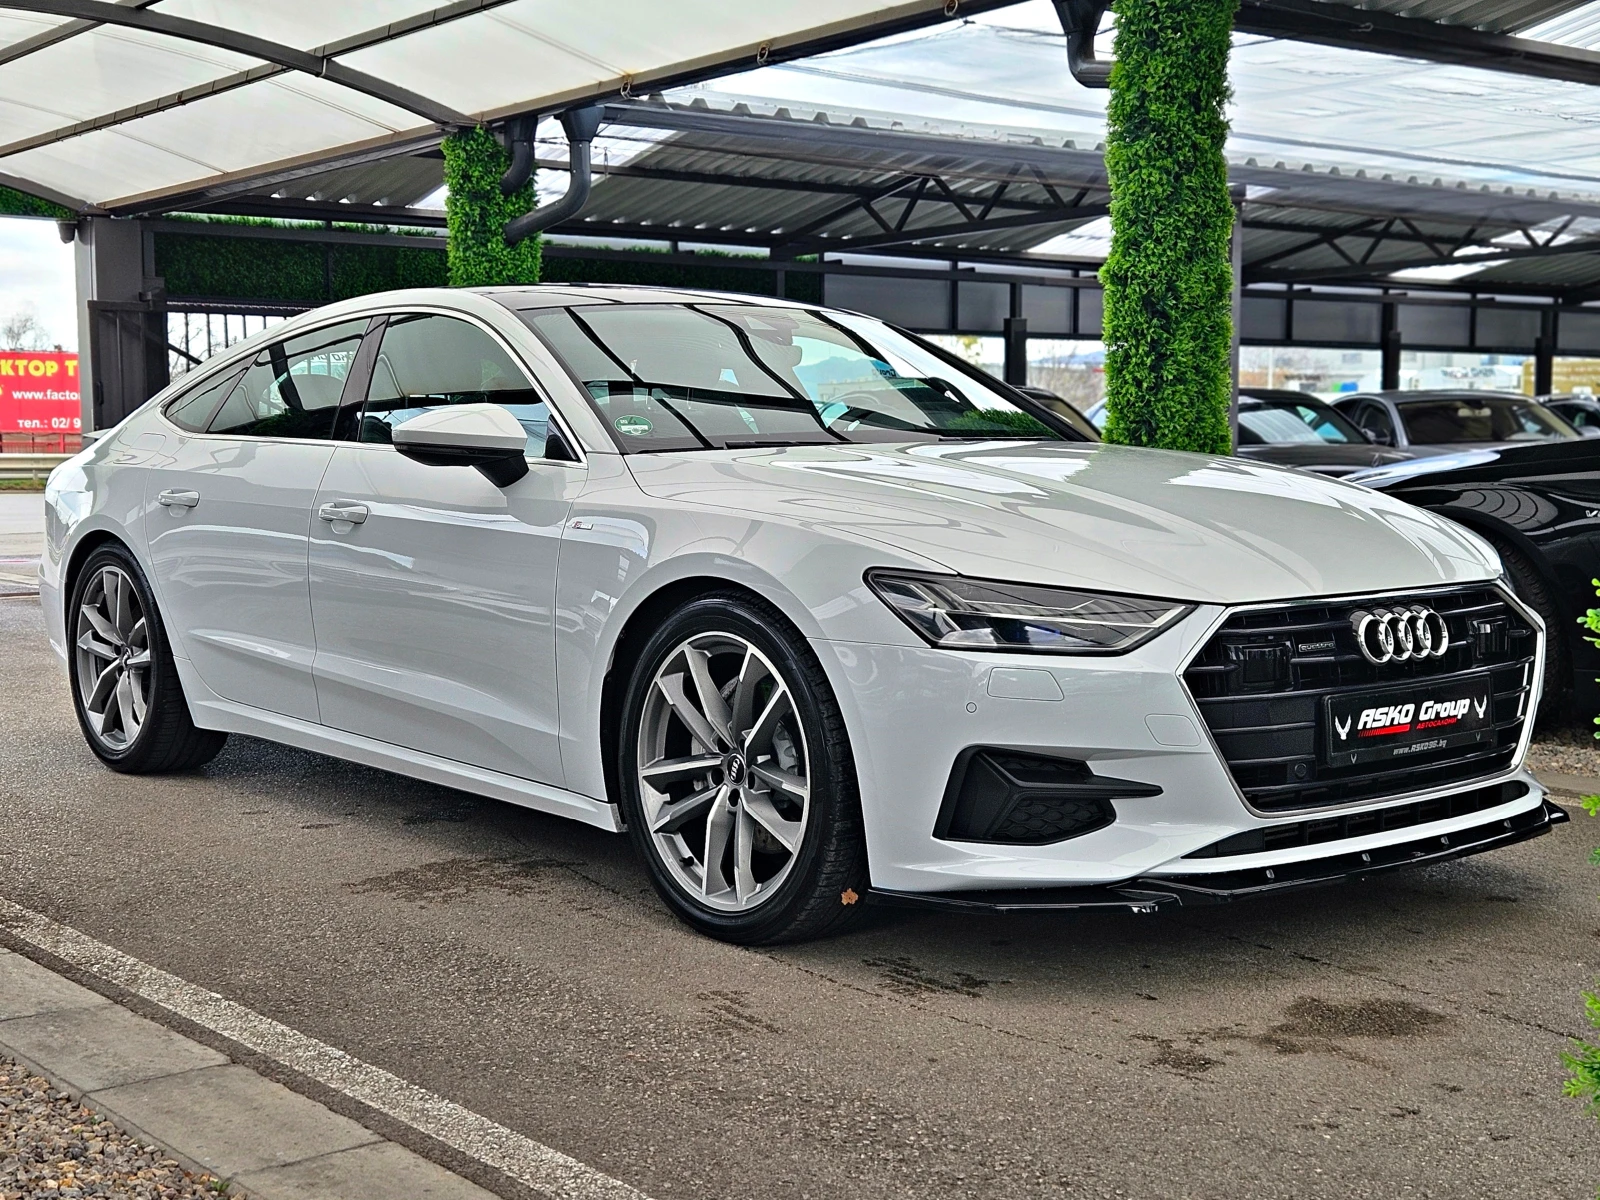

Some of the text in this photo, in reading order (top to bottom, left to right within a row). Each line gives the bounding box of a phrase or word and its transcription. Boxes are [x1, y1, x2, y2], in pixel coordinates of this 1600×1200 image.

[51, 417, 70, 429] 02/
[1357, 698, 1471, 730] ASKO Group
